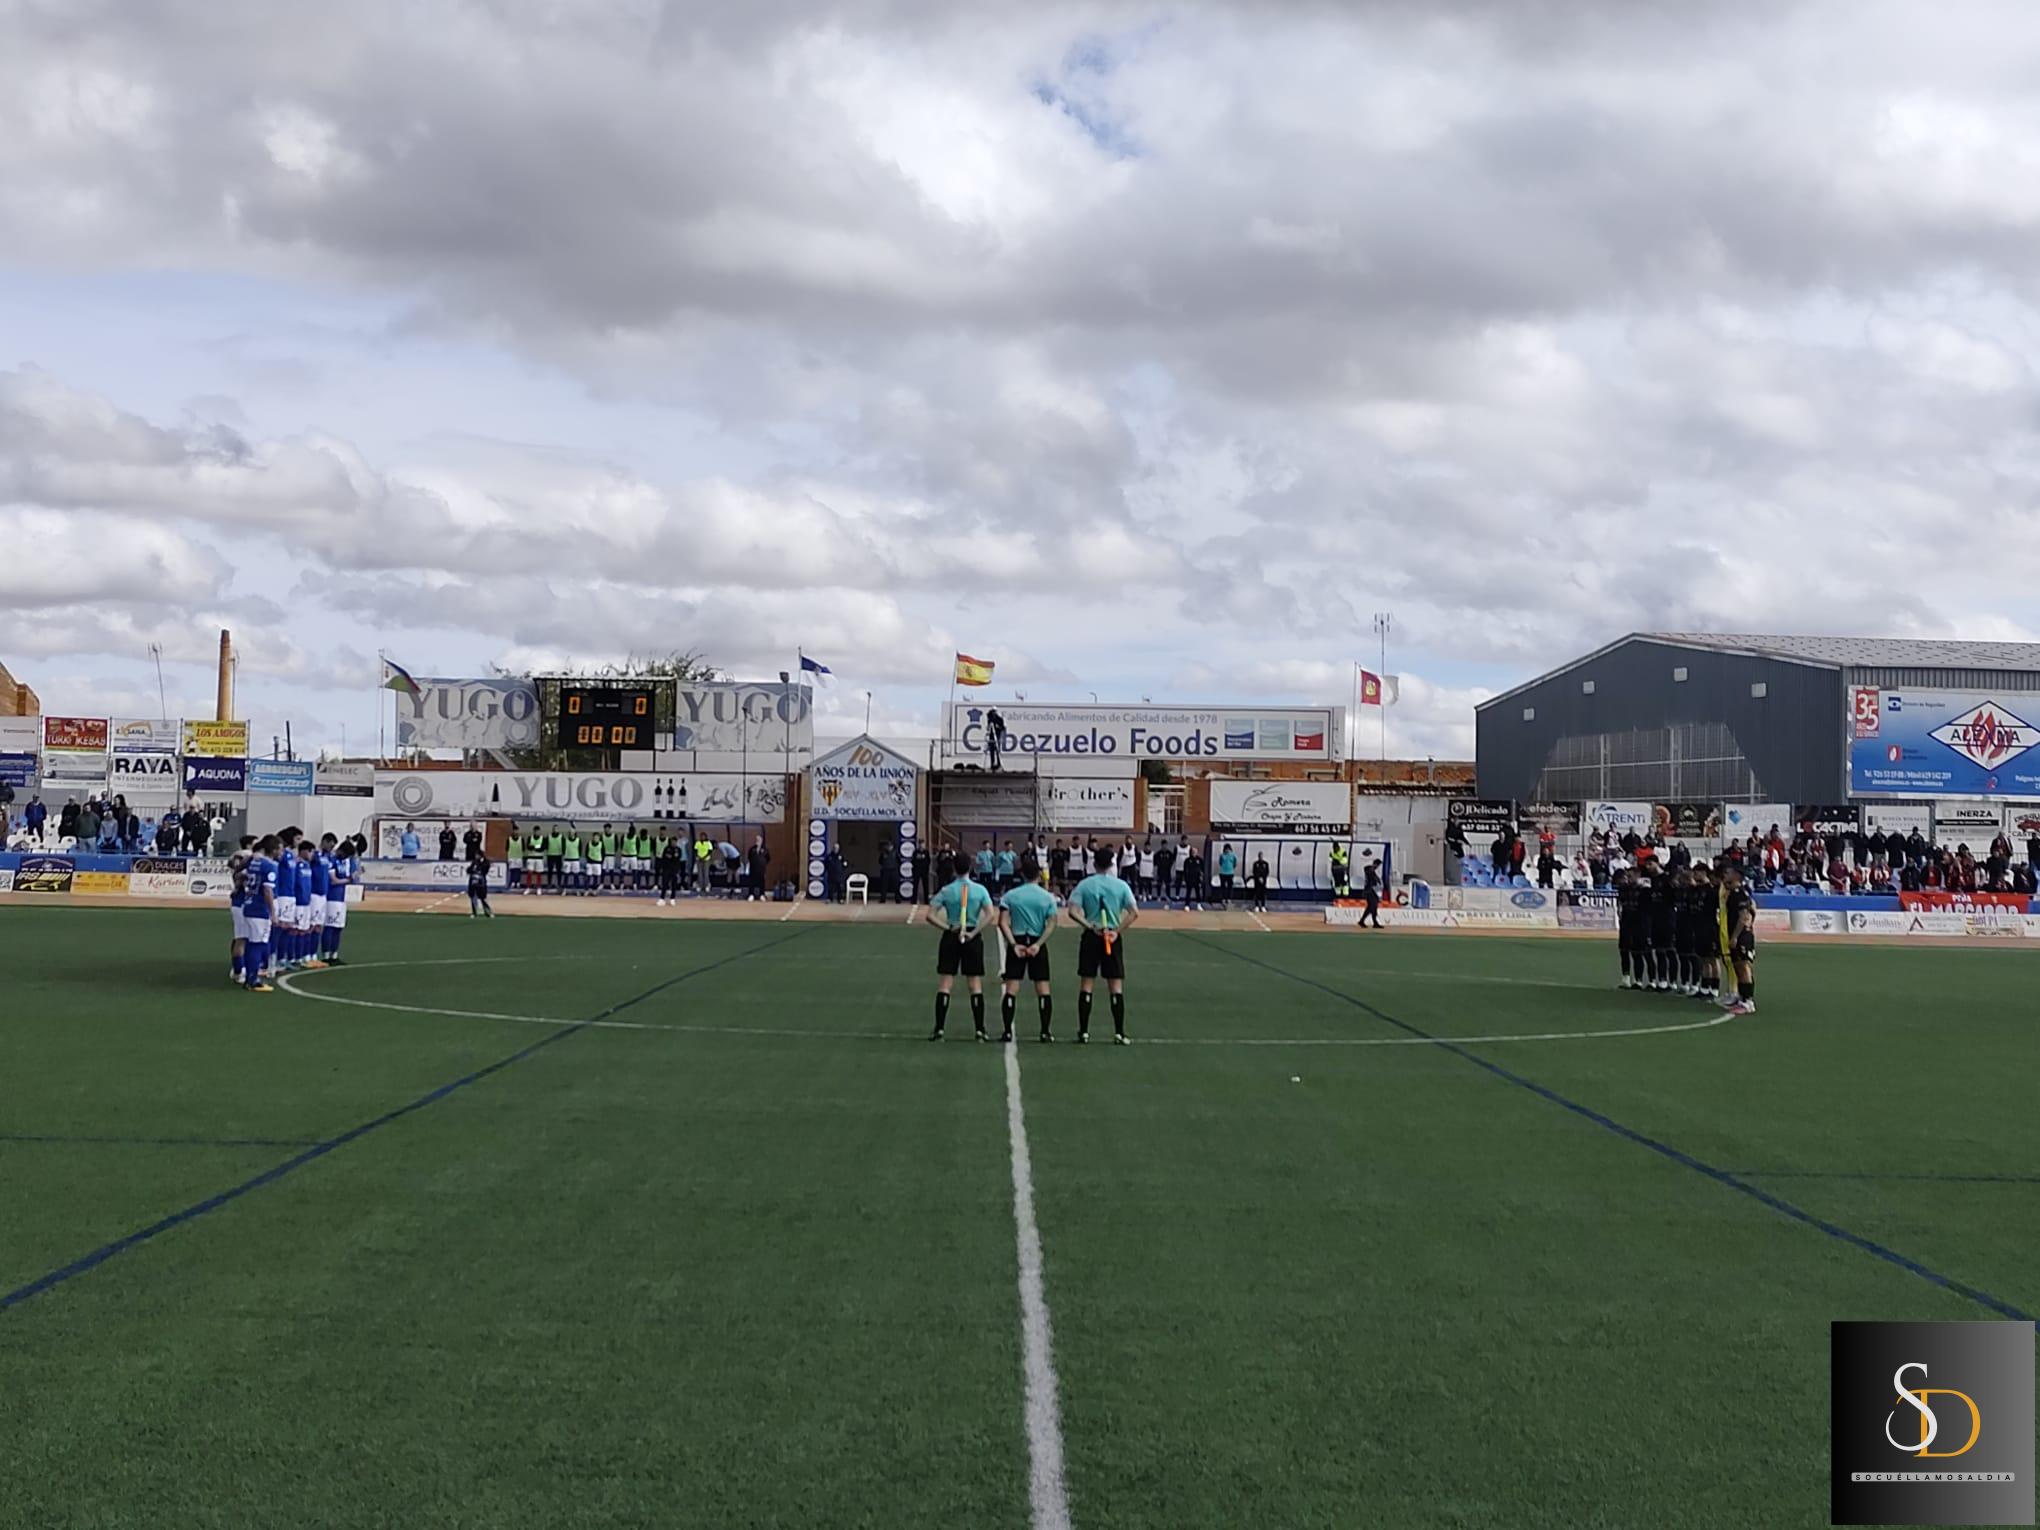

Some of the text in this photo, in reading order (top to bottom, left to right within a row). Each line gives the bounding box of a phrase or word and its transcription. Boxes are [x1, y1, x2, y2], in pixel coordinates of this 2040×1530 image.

[408, 688, 535, 721] YUGO
[568, 696, 581, 715] 0
[634, 697, 648, 715] 0
[681, 691, 807, 724] YUGO
[1856, 693, 1879, 731] 35
[1002, 711, 1218, 724] Fabricando Alimentos de Calidad desde 1978
[962, 723, 1218, 755] Cbezuelo Foods
[848, 744, 884, 766] 100
[115, 758, 173, 774] RAYA
[198, 768, 241, 780] AQUONA
[814, 764, 845, 778] AÑOS
[847, 767, 860, 778] DE
[863, 767, 877, 778] LA
[513, 776, 643, 809] YUGO
[1931, 903, 2019, 914] MARCADOR
